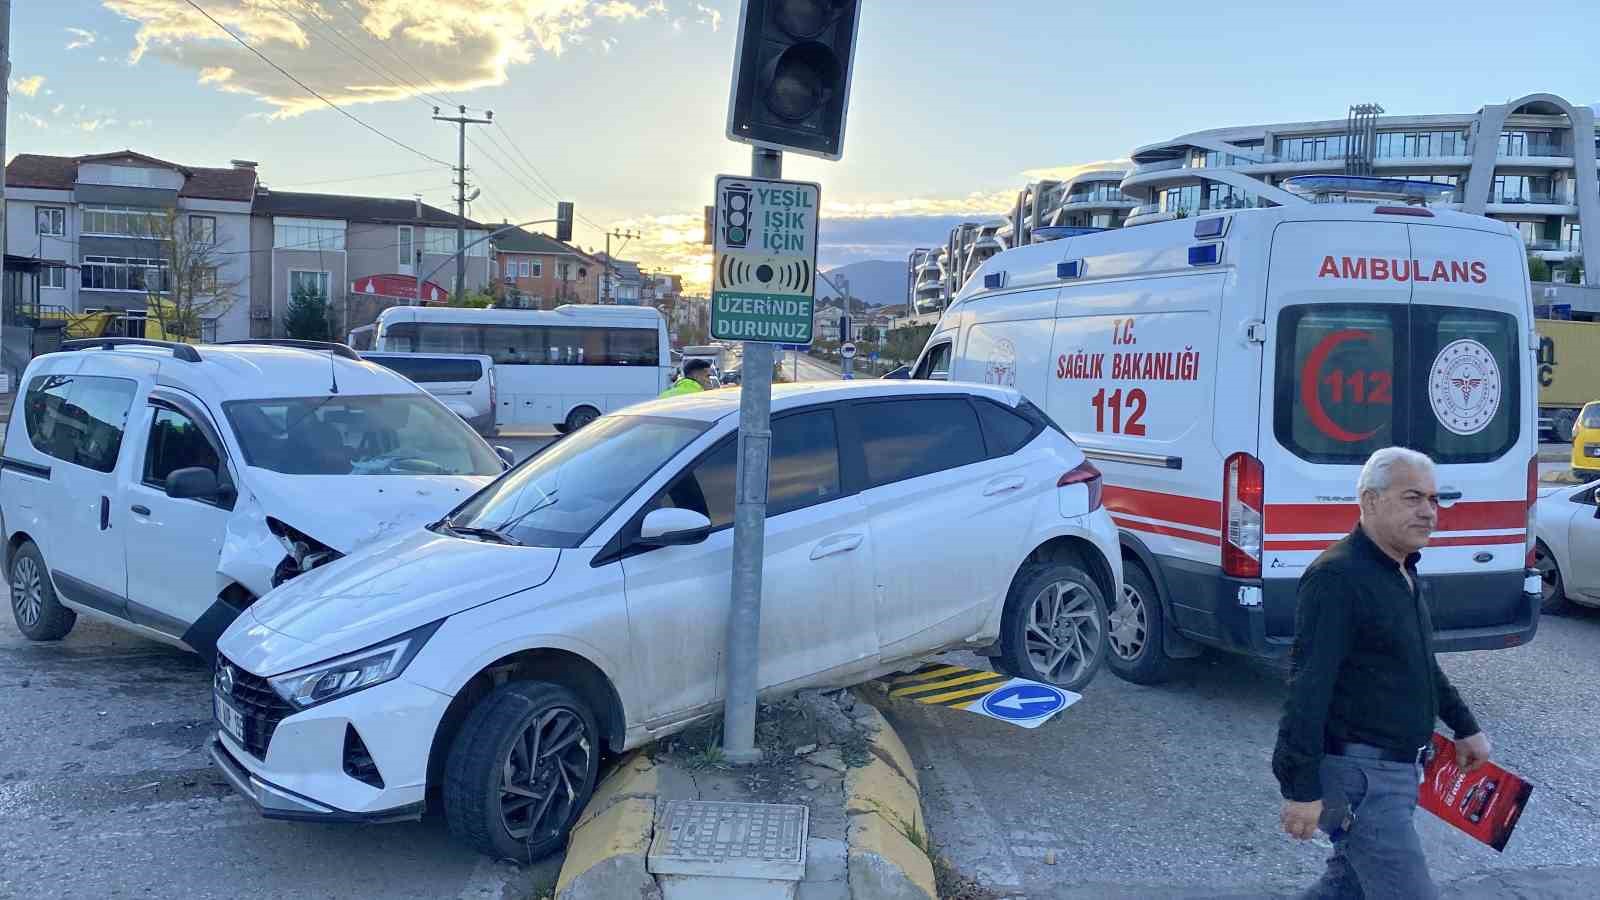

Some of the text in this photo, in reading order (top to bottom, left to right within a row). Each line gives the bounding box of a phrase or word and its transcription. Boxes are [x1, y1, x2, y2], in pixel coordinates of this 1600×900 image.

[757, 187, 812, 211] YEŞİL
[763, 229, 804, 254] İÇİN
[1318, 256, 1487, 283] AMBULANS
[718, 294, 809, 316] ÜZERİNDE
[718, 320, 808, 338] DURUNUZ
[1113, 319, 1136, 344] T.C.
[1057, 345, 1199, 380] SAĞLIK BAKANLIĞI
[1324, 369, 1392, 404] 112
[1091, 388, 1147, 436] 112
